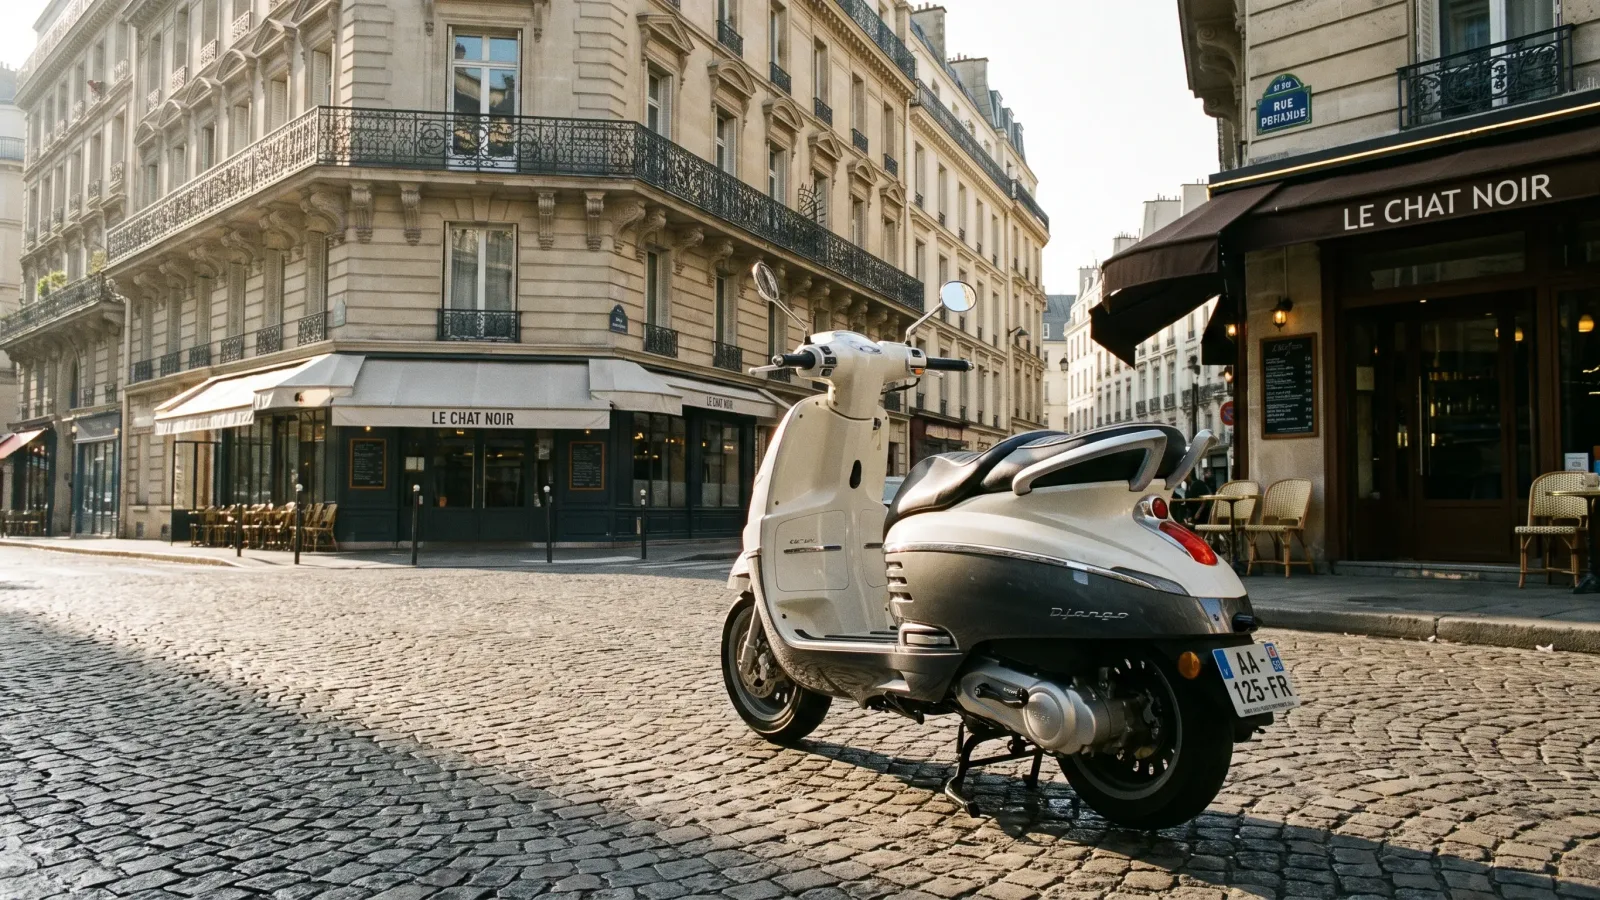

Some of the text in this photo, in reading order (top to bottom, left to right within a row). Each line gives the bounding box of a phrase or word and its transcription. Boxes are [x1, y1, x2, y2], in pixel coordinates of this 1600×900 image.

[1273, 98, 1294, 111] RUE
[1344, 174, 1552, 230] LE CHAT NOIR
[432, 411, 514, 426] LE CHAT NOIR
[1050, 607, 1129, 620] Django
[1234, 675, 1293, 704] 125-FR
